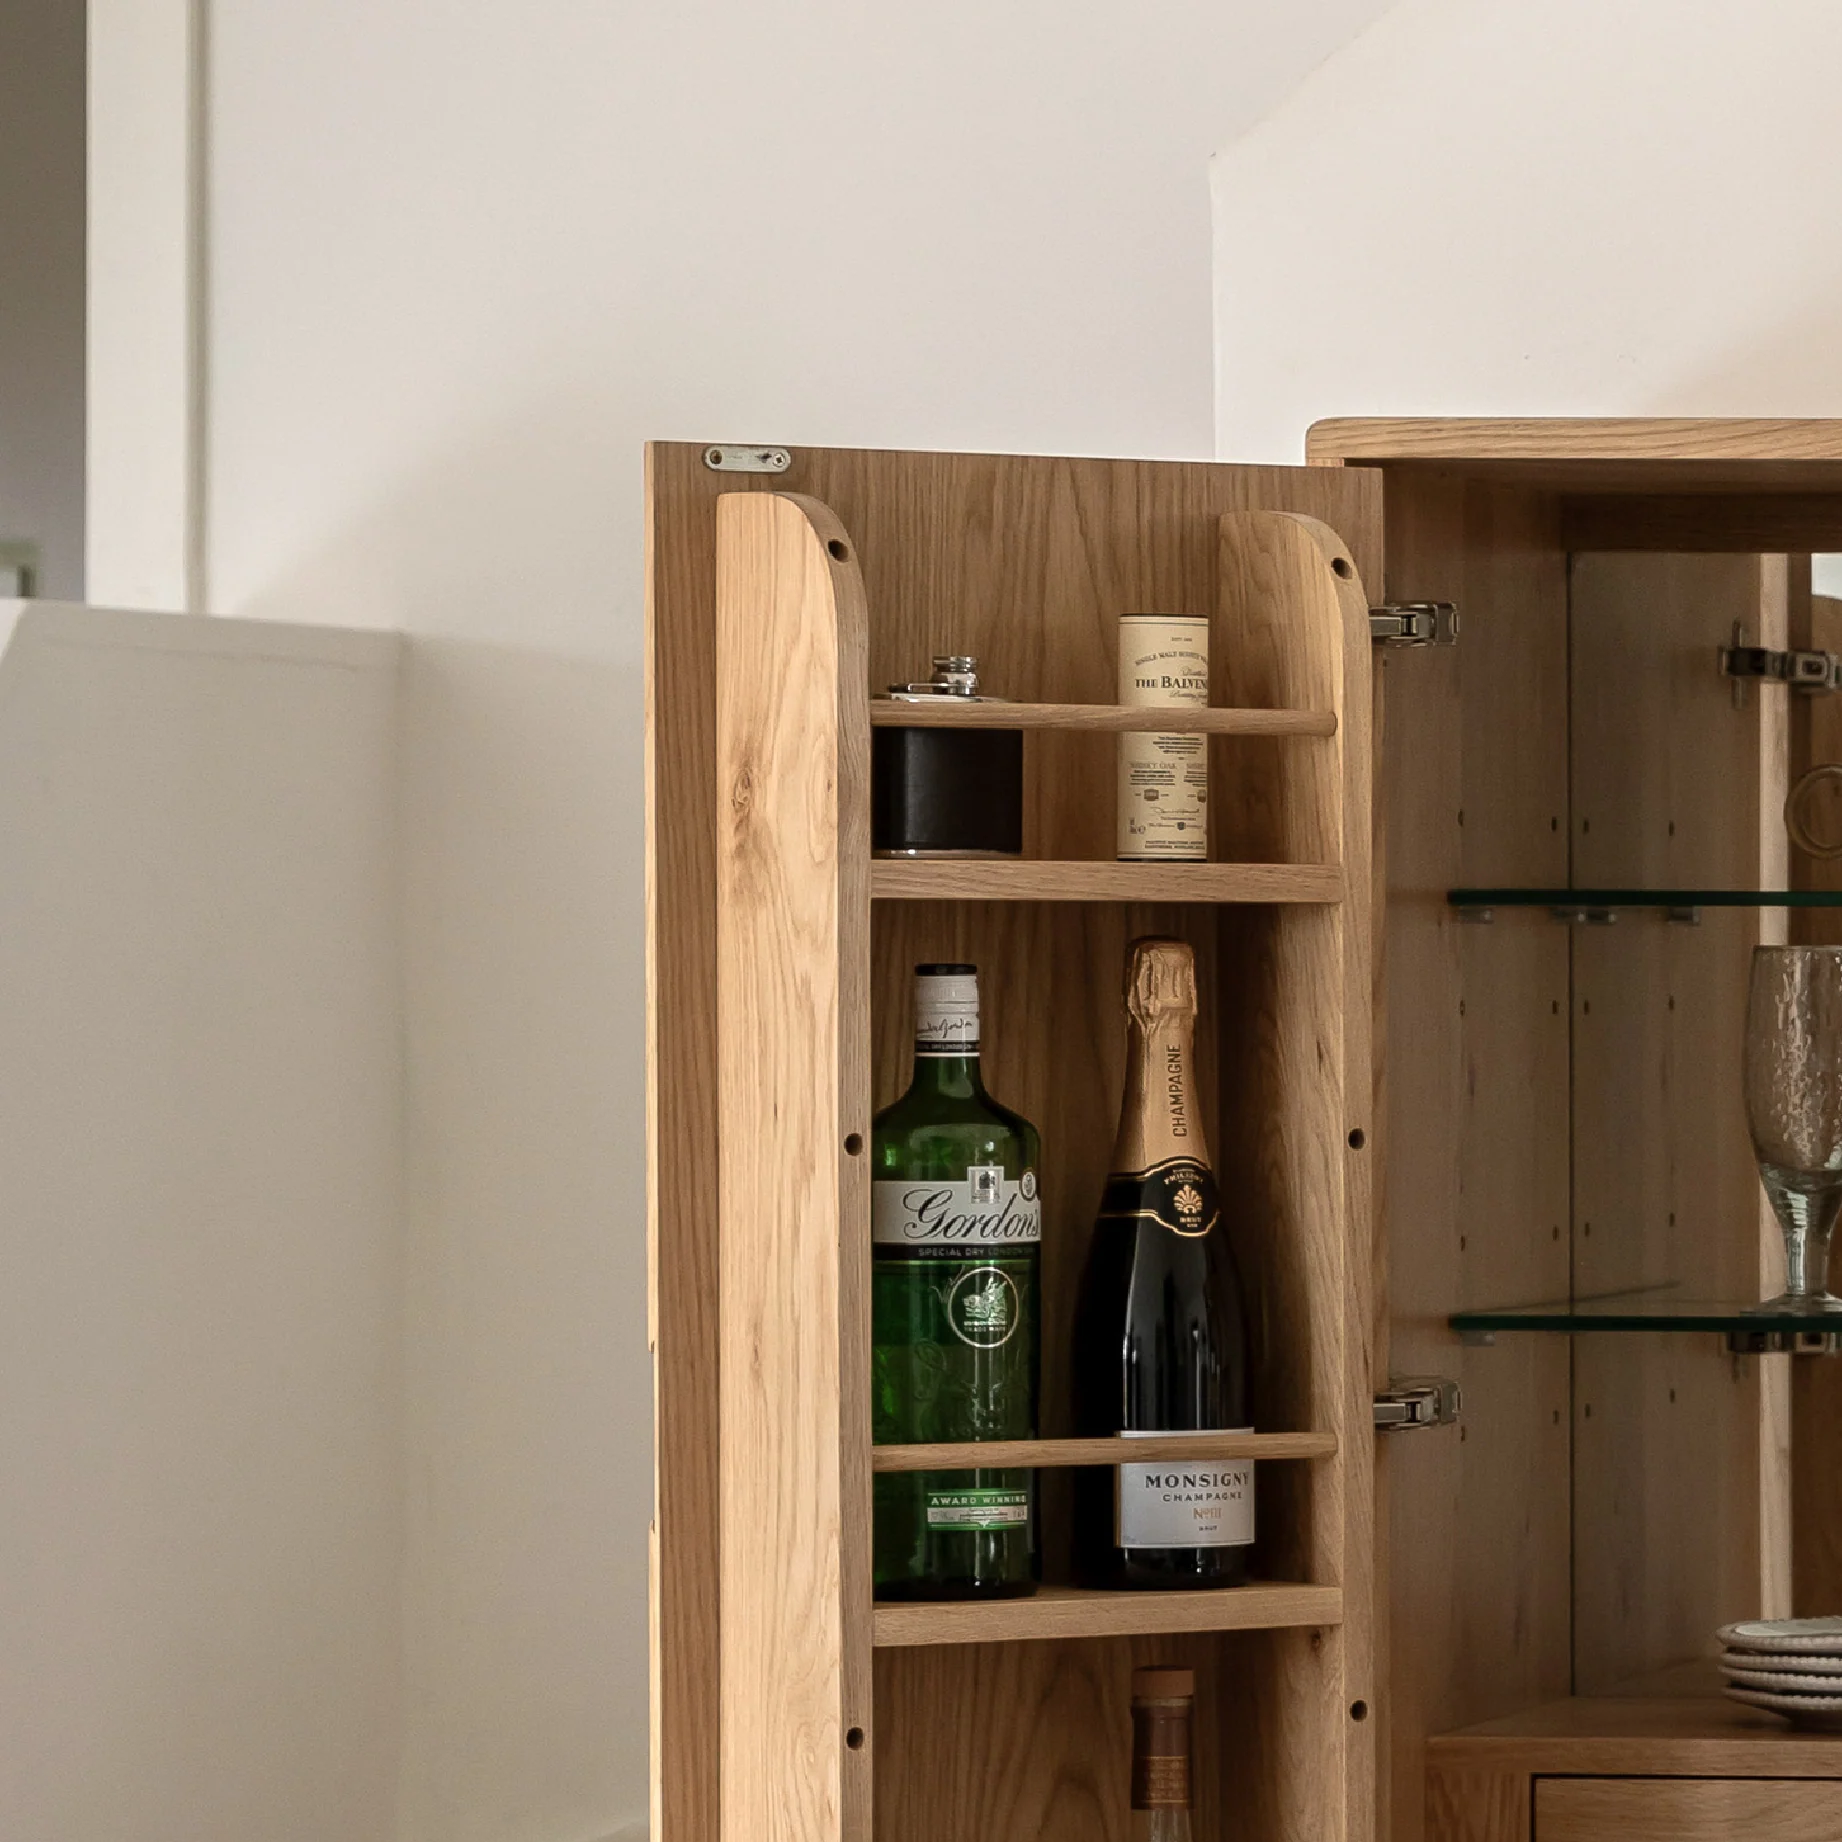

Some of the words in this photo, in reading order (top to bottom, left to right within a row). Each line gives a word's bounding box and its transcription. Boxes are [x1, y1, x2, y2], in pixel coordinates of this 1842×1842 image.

[1134, 678, 1159, 689] THE
[1165, 1043, 1187, 1138] CHAMPAGNE
[918, 1247, 962, 1257] SPECIAL
[965, 1247, 985, 1257] DRY
[1145, 1472, 1250, 1488] MONSIGNY
[931, 1497, 977, 1505] AWARD
[1162, 1491, 1242, 1502] CHAMPAGNE
